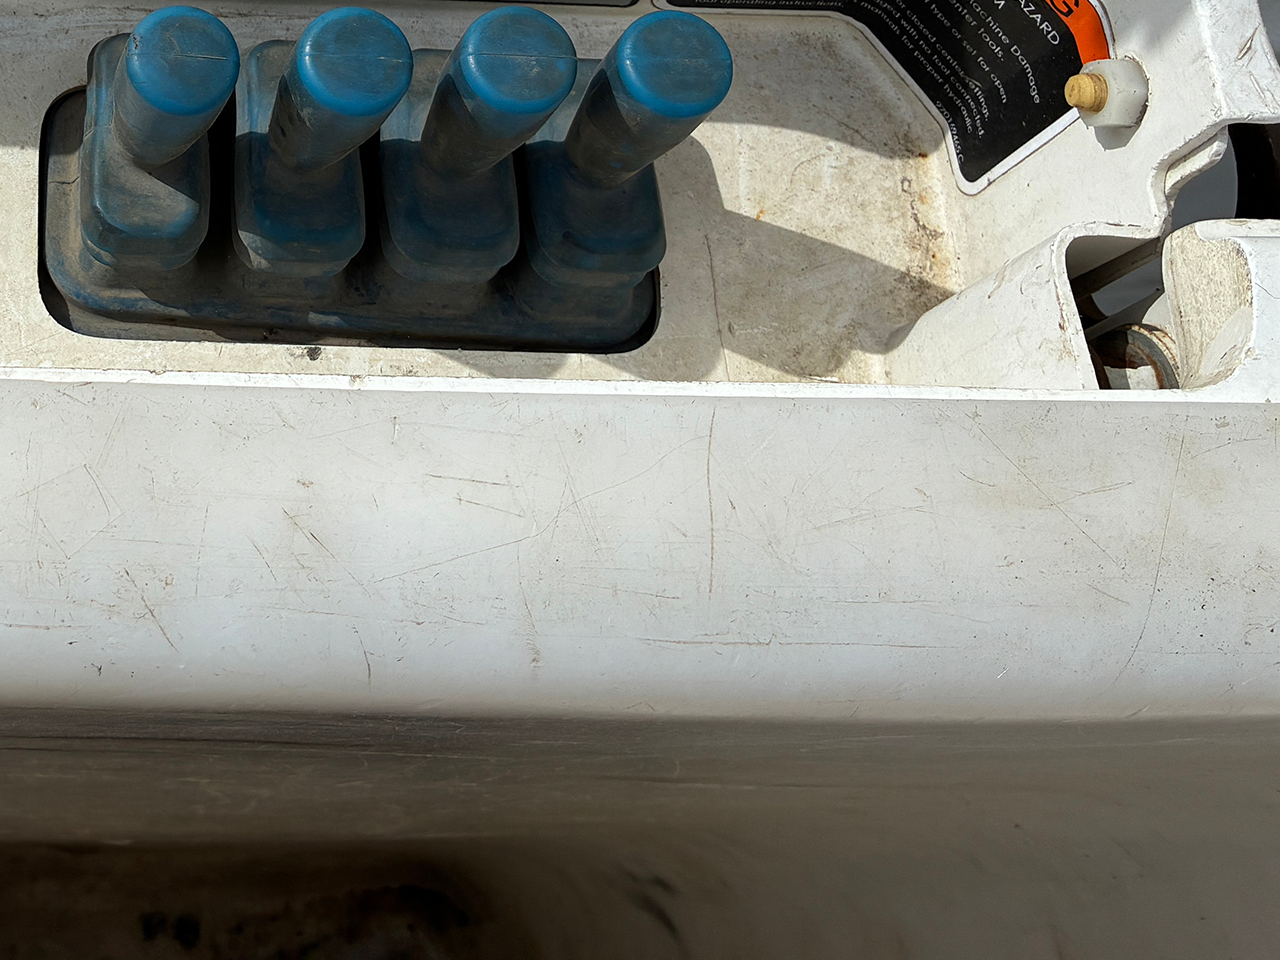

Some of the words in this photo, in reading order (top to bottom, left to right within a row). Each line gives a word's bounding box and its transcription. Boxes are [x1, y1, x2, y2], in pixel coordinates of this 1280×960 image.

[900, 18, 919, 40] with
[918, 40, 931, 54] no
[932, 54, 951, 76] tool
[906, 9, 937, 43] closed
[930, 3, 951, 27] type
[951, 27, 962, 39] or
[961, 39, 978, 56] set
[976, 56, 990, 72] for
[990, 73, 1007, 104] open
[978, 27, 1005, 61] tools.
[1010, 45, 1040, 104] Damage
